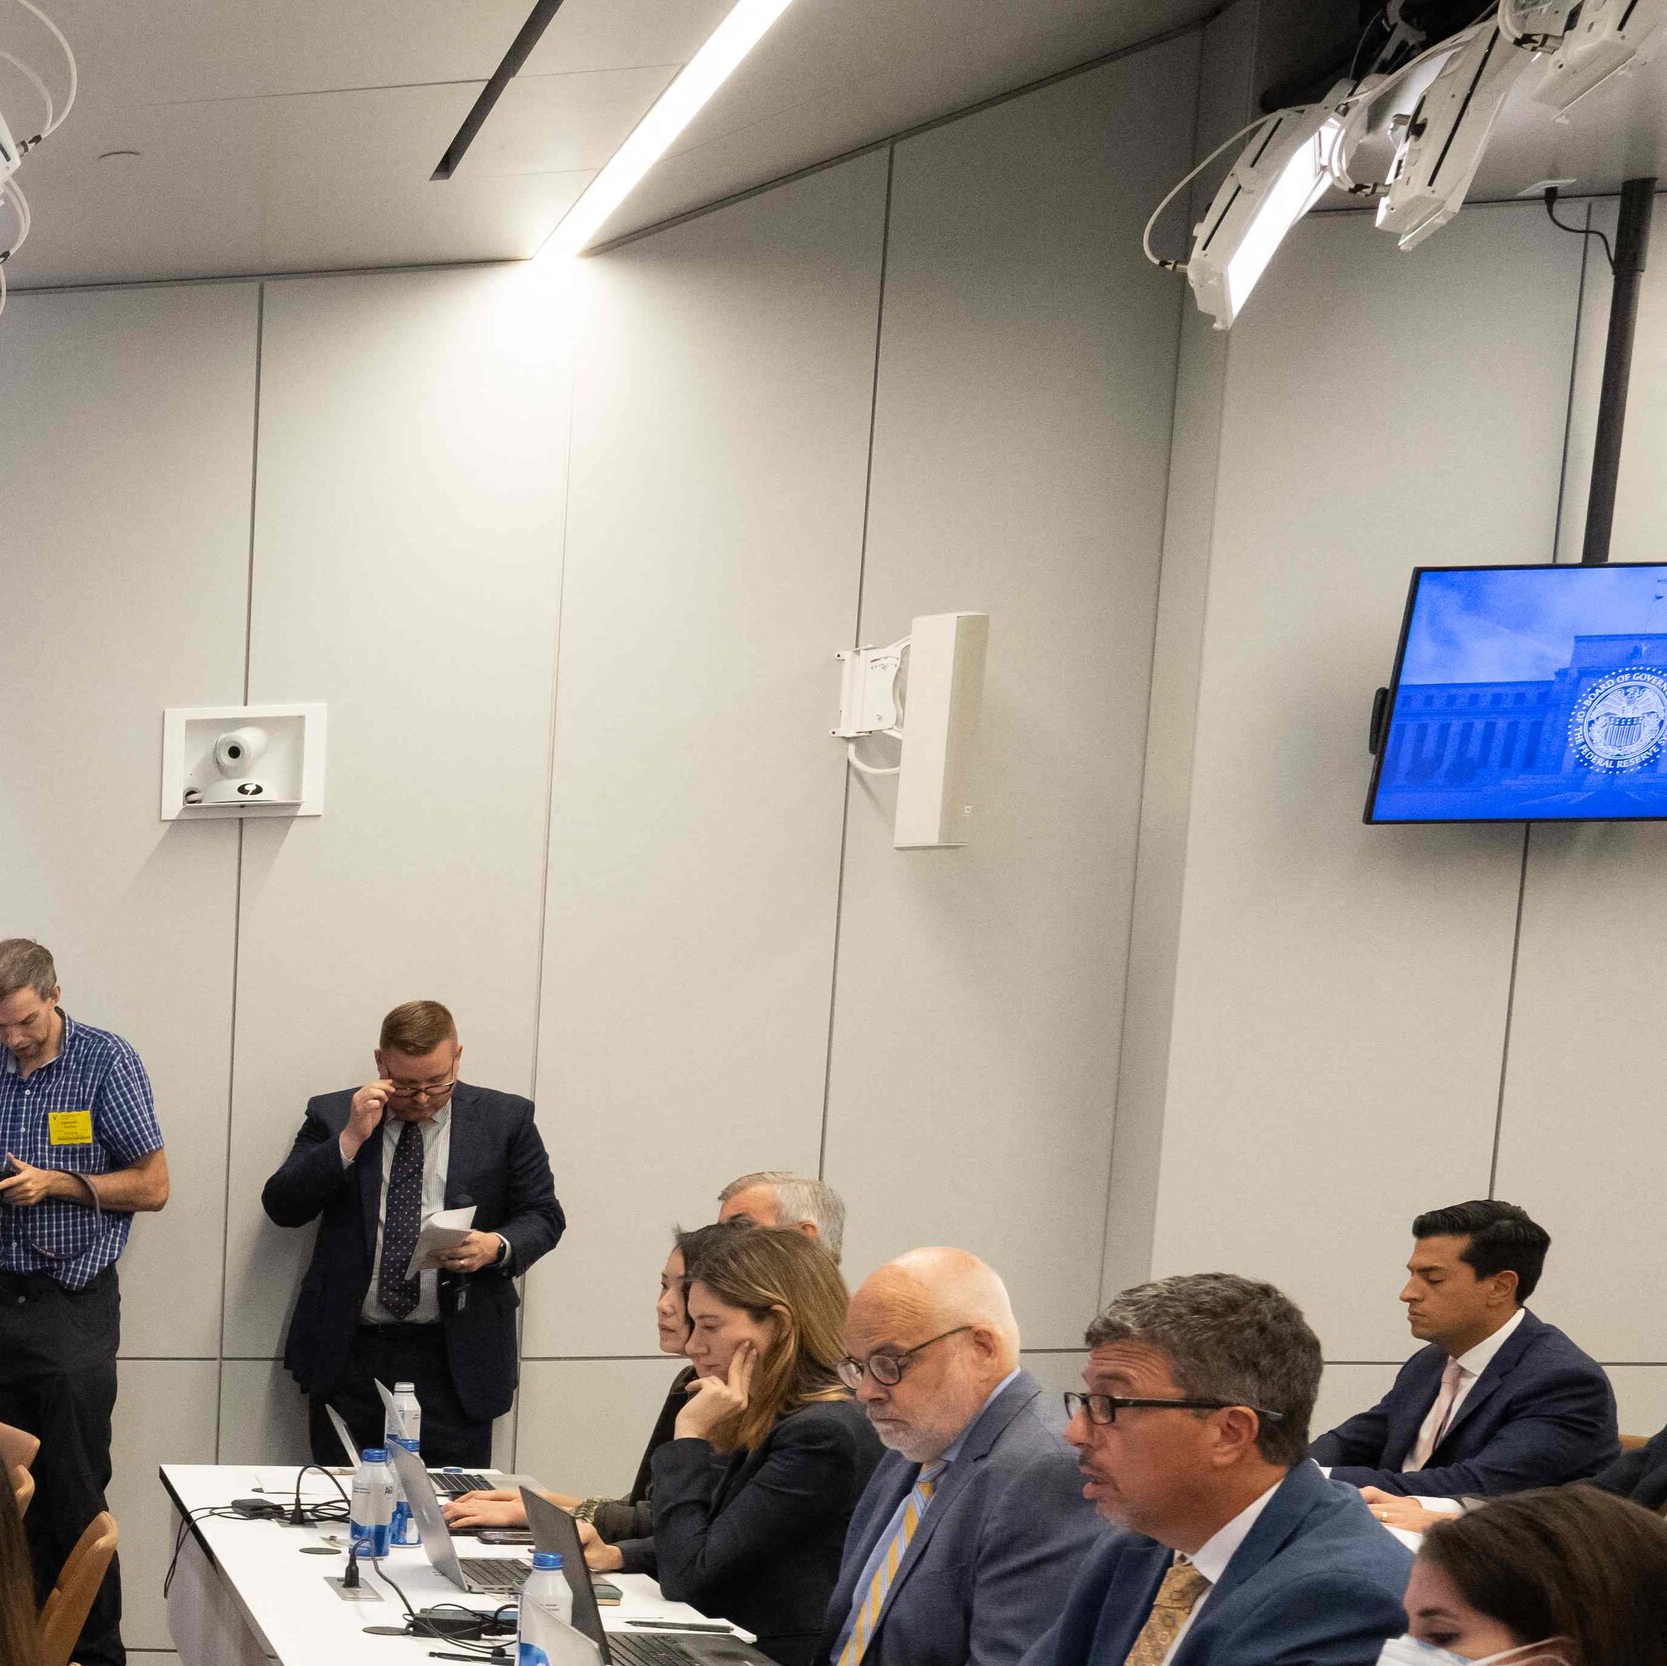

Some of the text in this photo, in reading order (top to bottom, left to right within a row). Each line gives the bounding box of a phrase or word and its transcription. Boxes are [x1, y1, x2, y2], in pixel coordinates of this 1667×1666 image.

[1583, 679, 1614, 706] BOARD
[1616, 674, 1631, 683] OF
[1574, 726, 1584, 745] THE
[1579, 744, 1614, 768] FEDERAL
[1616, 745, 1660, 769] RESERVE
